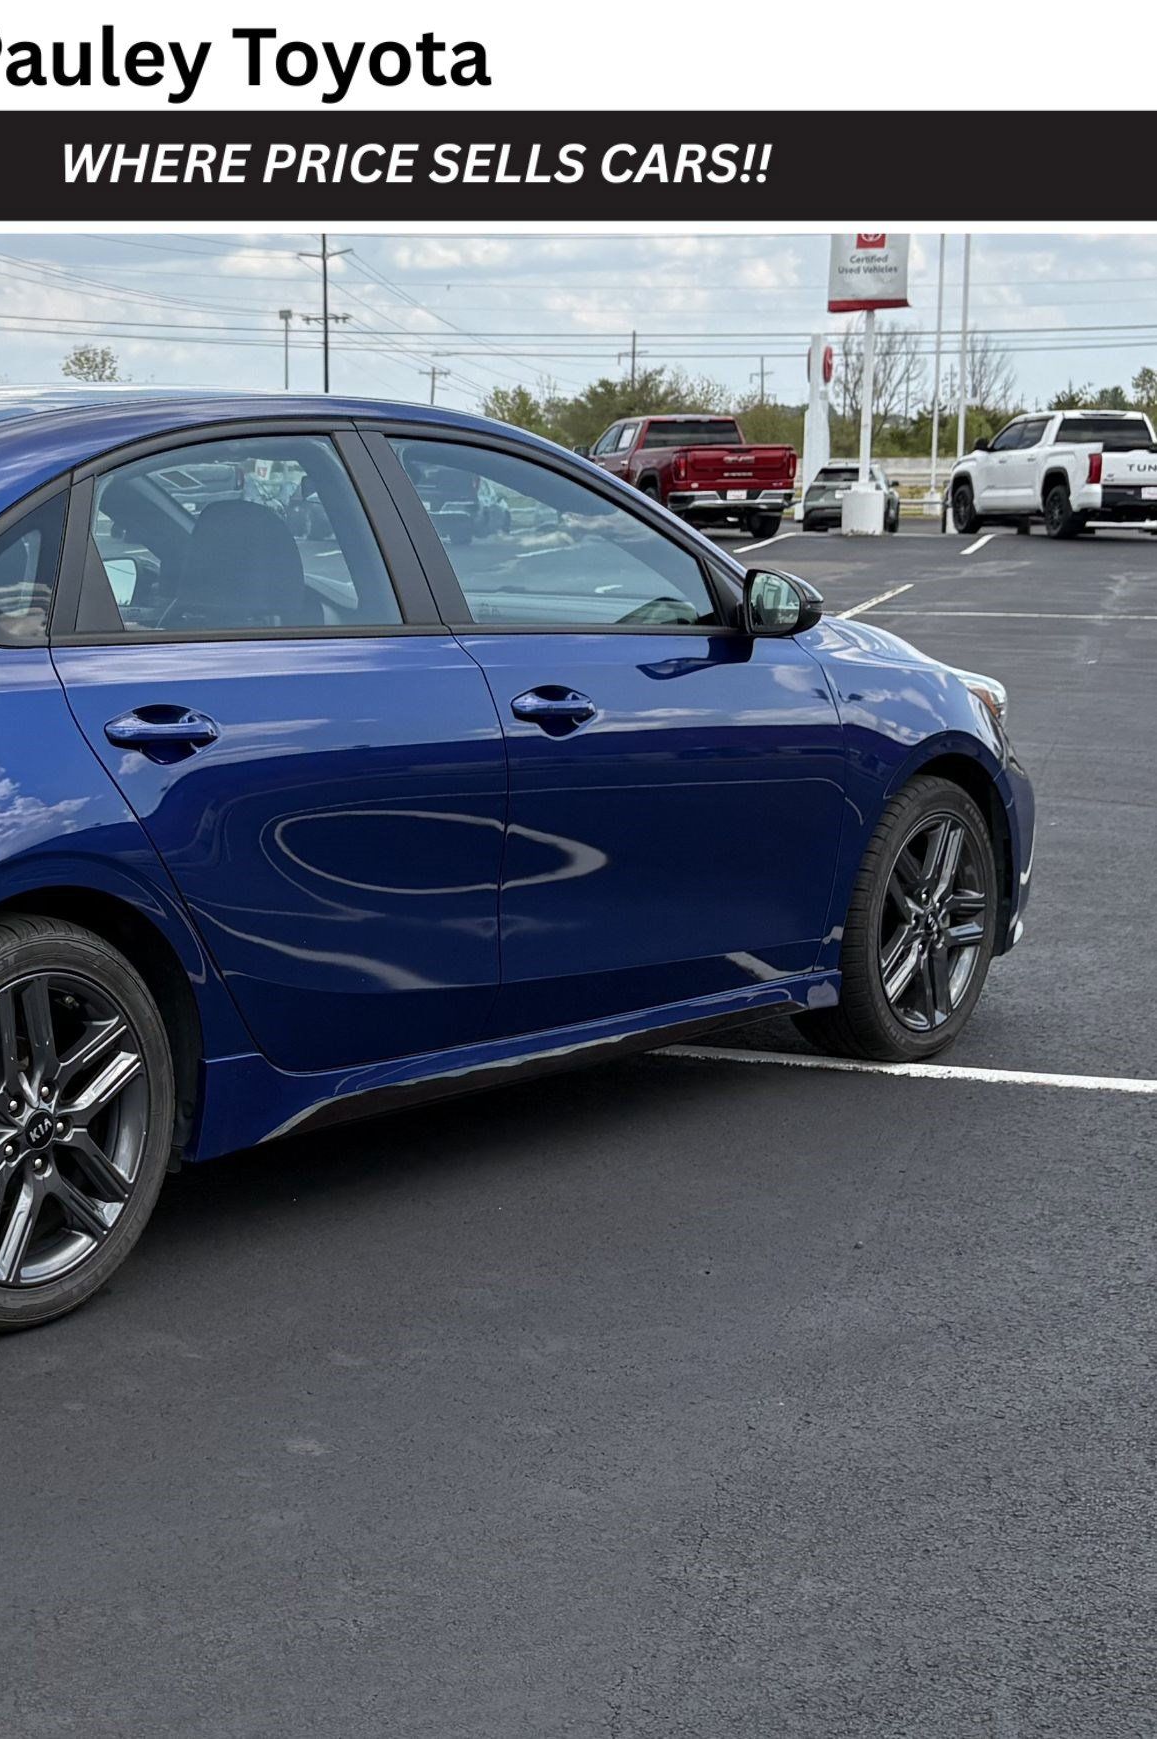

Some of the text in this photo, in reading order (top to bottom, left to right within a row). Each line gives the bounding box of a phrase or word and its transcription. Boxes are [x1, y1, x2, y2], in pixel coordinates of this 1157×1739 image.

[849, 254, 889, 264] Certified
[838, 265, 898, 274] Used Vehicles
[29, 1118, 52, 1142] KIA
